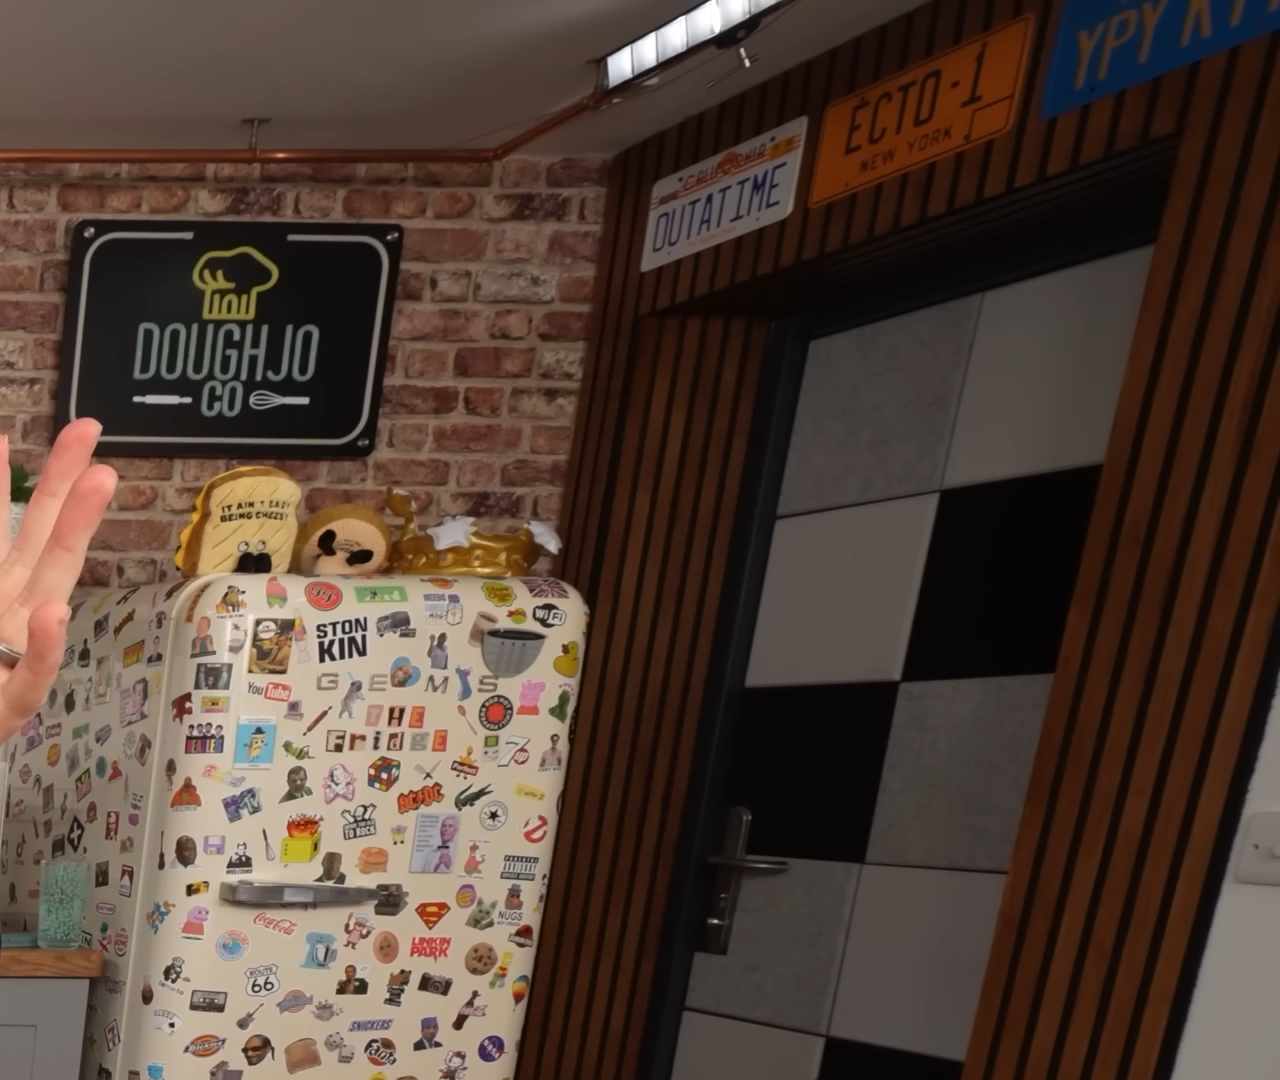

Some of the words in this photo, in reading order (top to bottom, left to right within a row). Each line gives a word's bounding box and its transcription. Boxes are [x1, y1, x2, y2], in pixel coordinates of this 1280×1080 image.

[844, 40, 989, 157] ECTO-1
[859, 151, 898, 175] NEW
[907, 123, 955, 156] YORK
[652, 161, 788, 253] OUTATIME
[133, 322, 320, 382] DOUGHJO
[200, 380, 244, 418] CO
[221, 503, 233, 514] IT
[220, 511, 254, 523] BEING
[316, 617, 368, 639] STON
[318, 634, 368, 664] KIN
[186, 736, 224, 753] BEATLES
[452, 763, 478, 775] Perfect
[344, 829, 355, 839] TO
[356, 826, 375, 837] ROCK
[498, 911, 523, 921] NUGS
[411, 937, 451, 946] LINKIN
[409, 946, 449, 963] PARK
[249, 968, 274, 977] ROUTE
[251, 979, 275, 994] 66
[350, 1019, 392, 1032] SNICKERS
[189, 1040, 223, 1052] Dickies
[364, 1039, 397, 1066] Fanta
